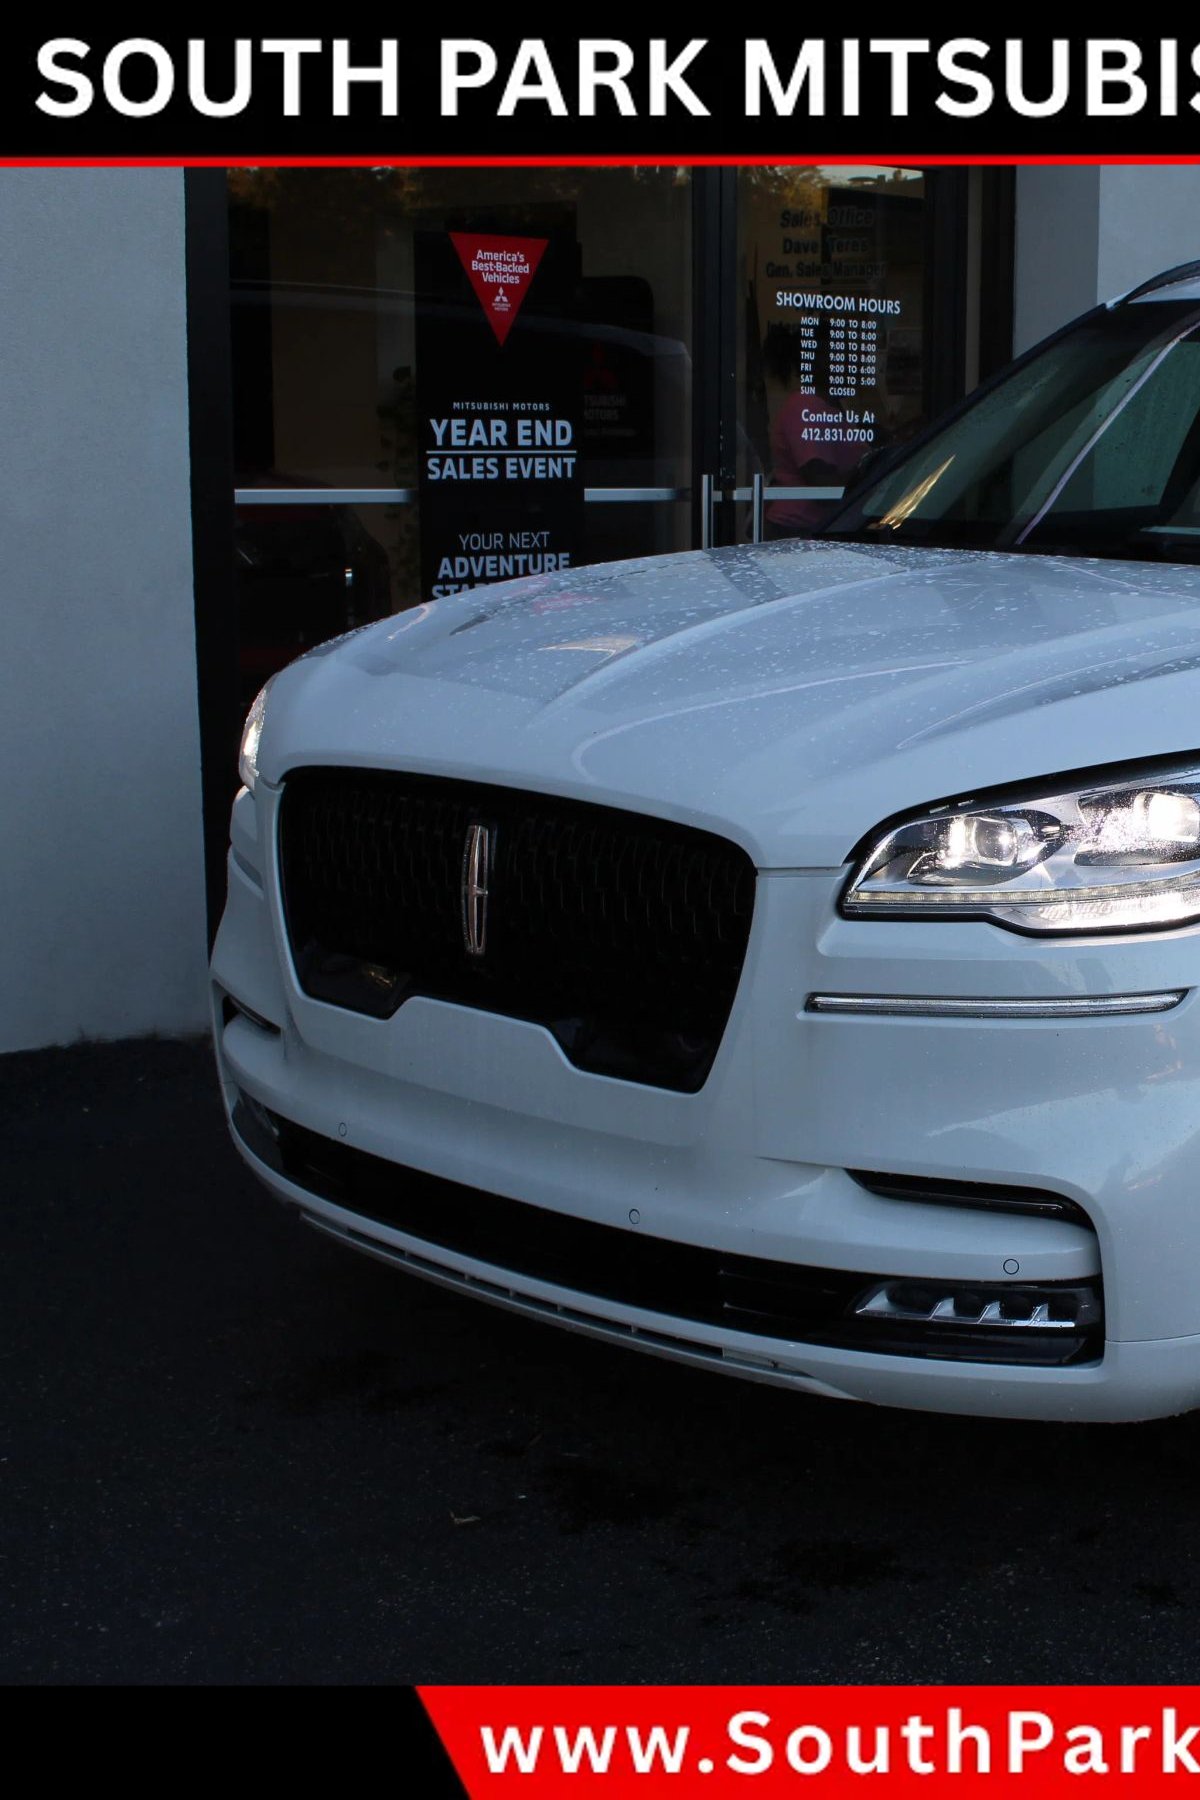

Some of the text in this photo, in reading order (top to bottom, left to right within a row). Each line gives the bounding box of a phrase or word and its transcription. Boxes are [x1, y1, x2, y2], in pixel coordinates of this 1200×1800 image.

[828, 205, 873, 227] Office
[783, 238, 818, 254] Dave
[476, 250, 525, 263] America's
[471, 260, 529, 274] Best-Backed
[797, 262, 831, 278] Sales
[833, 261, 886, 280] Manager
[482, 272, 520, 285] Vehicles
[776, 291, 901, 315] SHOWROOM HOURS
[800, 316, 877, 330] MON 9:00 TO 8:00
[800, 328, 814, 337] TUE
[830, 330, 845, 340] 9:00
[848, 331, 857, 340] TO
[861, 332, 877, 341] 8:00
[800, 340, 877, 352] WED 9:00 TO 8:00
[800, 351, 876, 363] THU 9:00 TO 8:00
[800, 363, 876, 375] FRI 9:00 TO 6:00
[800, 374, 876, 386] SAT 9:00 TO 5:00
[800, 386, 856, 397] SUN CLOSED
[452, 401, 550, 411] MITSUBISHI MOTORS
[801, 409, 875, 423] Contact Us At
[430, 418, 572, 446] YEAR END
[801, 427, 874, 442] 412.831.0700
[427, 457, 576, 481] SALES EVENT
[459, 531, 551, 551] YOUR NEXT
[438, 552, 571, 579] ADVENTURE
